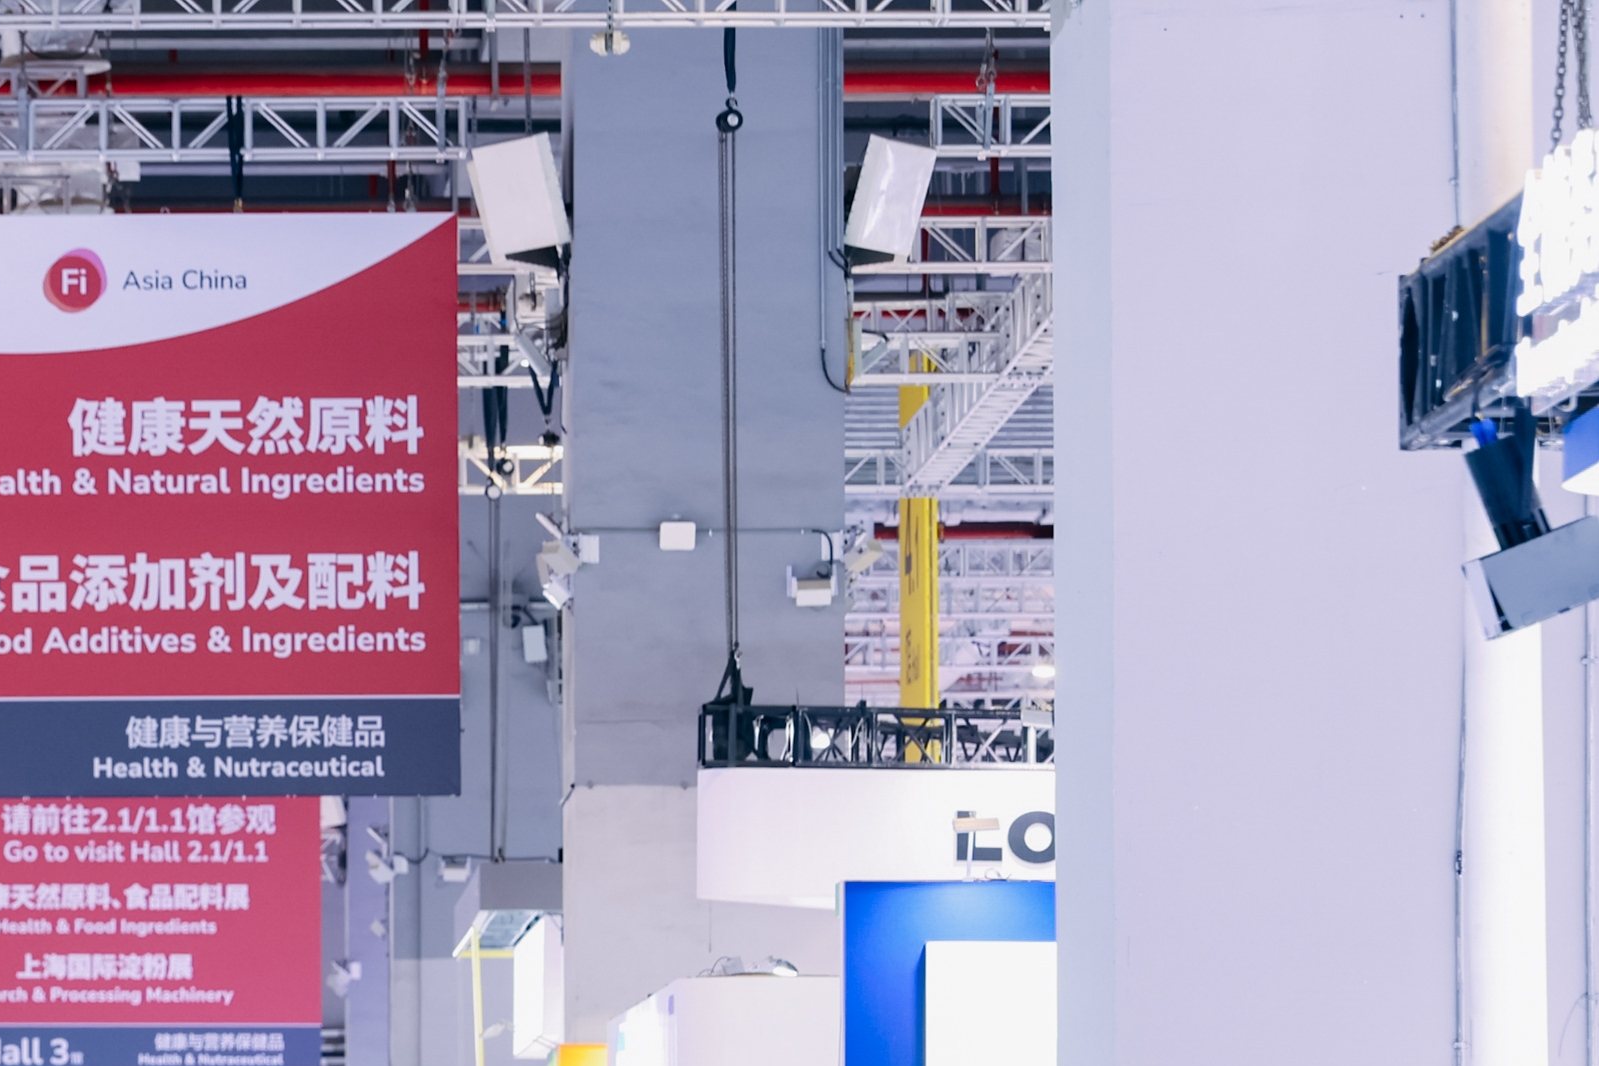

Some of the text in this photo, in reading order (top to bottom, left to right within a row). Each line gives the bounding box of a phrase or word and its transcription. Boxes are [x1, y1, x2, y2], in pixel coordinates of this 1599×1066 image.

[62, 269, 246, 294] Fi Asia China
[68, 395, 424, 456] 健康天然原料
[73, 468, 97, 494] &
[108, 467, 231, 494] Natural
[242, 466, 424, 499] Ingredients
[42, 626, 196, 653] Additives
[207, 626, 231, 652] &
[243, 625, 425, 658] Ingredients
[126, 715, 385, 749] 健康与营养保健品
[94, 755, 384, 778] Health & Nutraceutical
[4, 840, 268, 863] Go to visit Hall 2.1/1.1
[56, 918, 70, 934] &
[74, 918, 116, 934] Food
[120, 918, 217, 937] Ingredients
[32, 986, 46, 1002] &
[50, 986, 142, 1005] Processing
[146, 986, 234, 1005] Machinery
[50, 1038, 71, 1065] 3
[138, 1053, 284, 1066] Health & Nutraceutical
